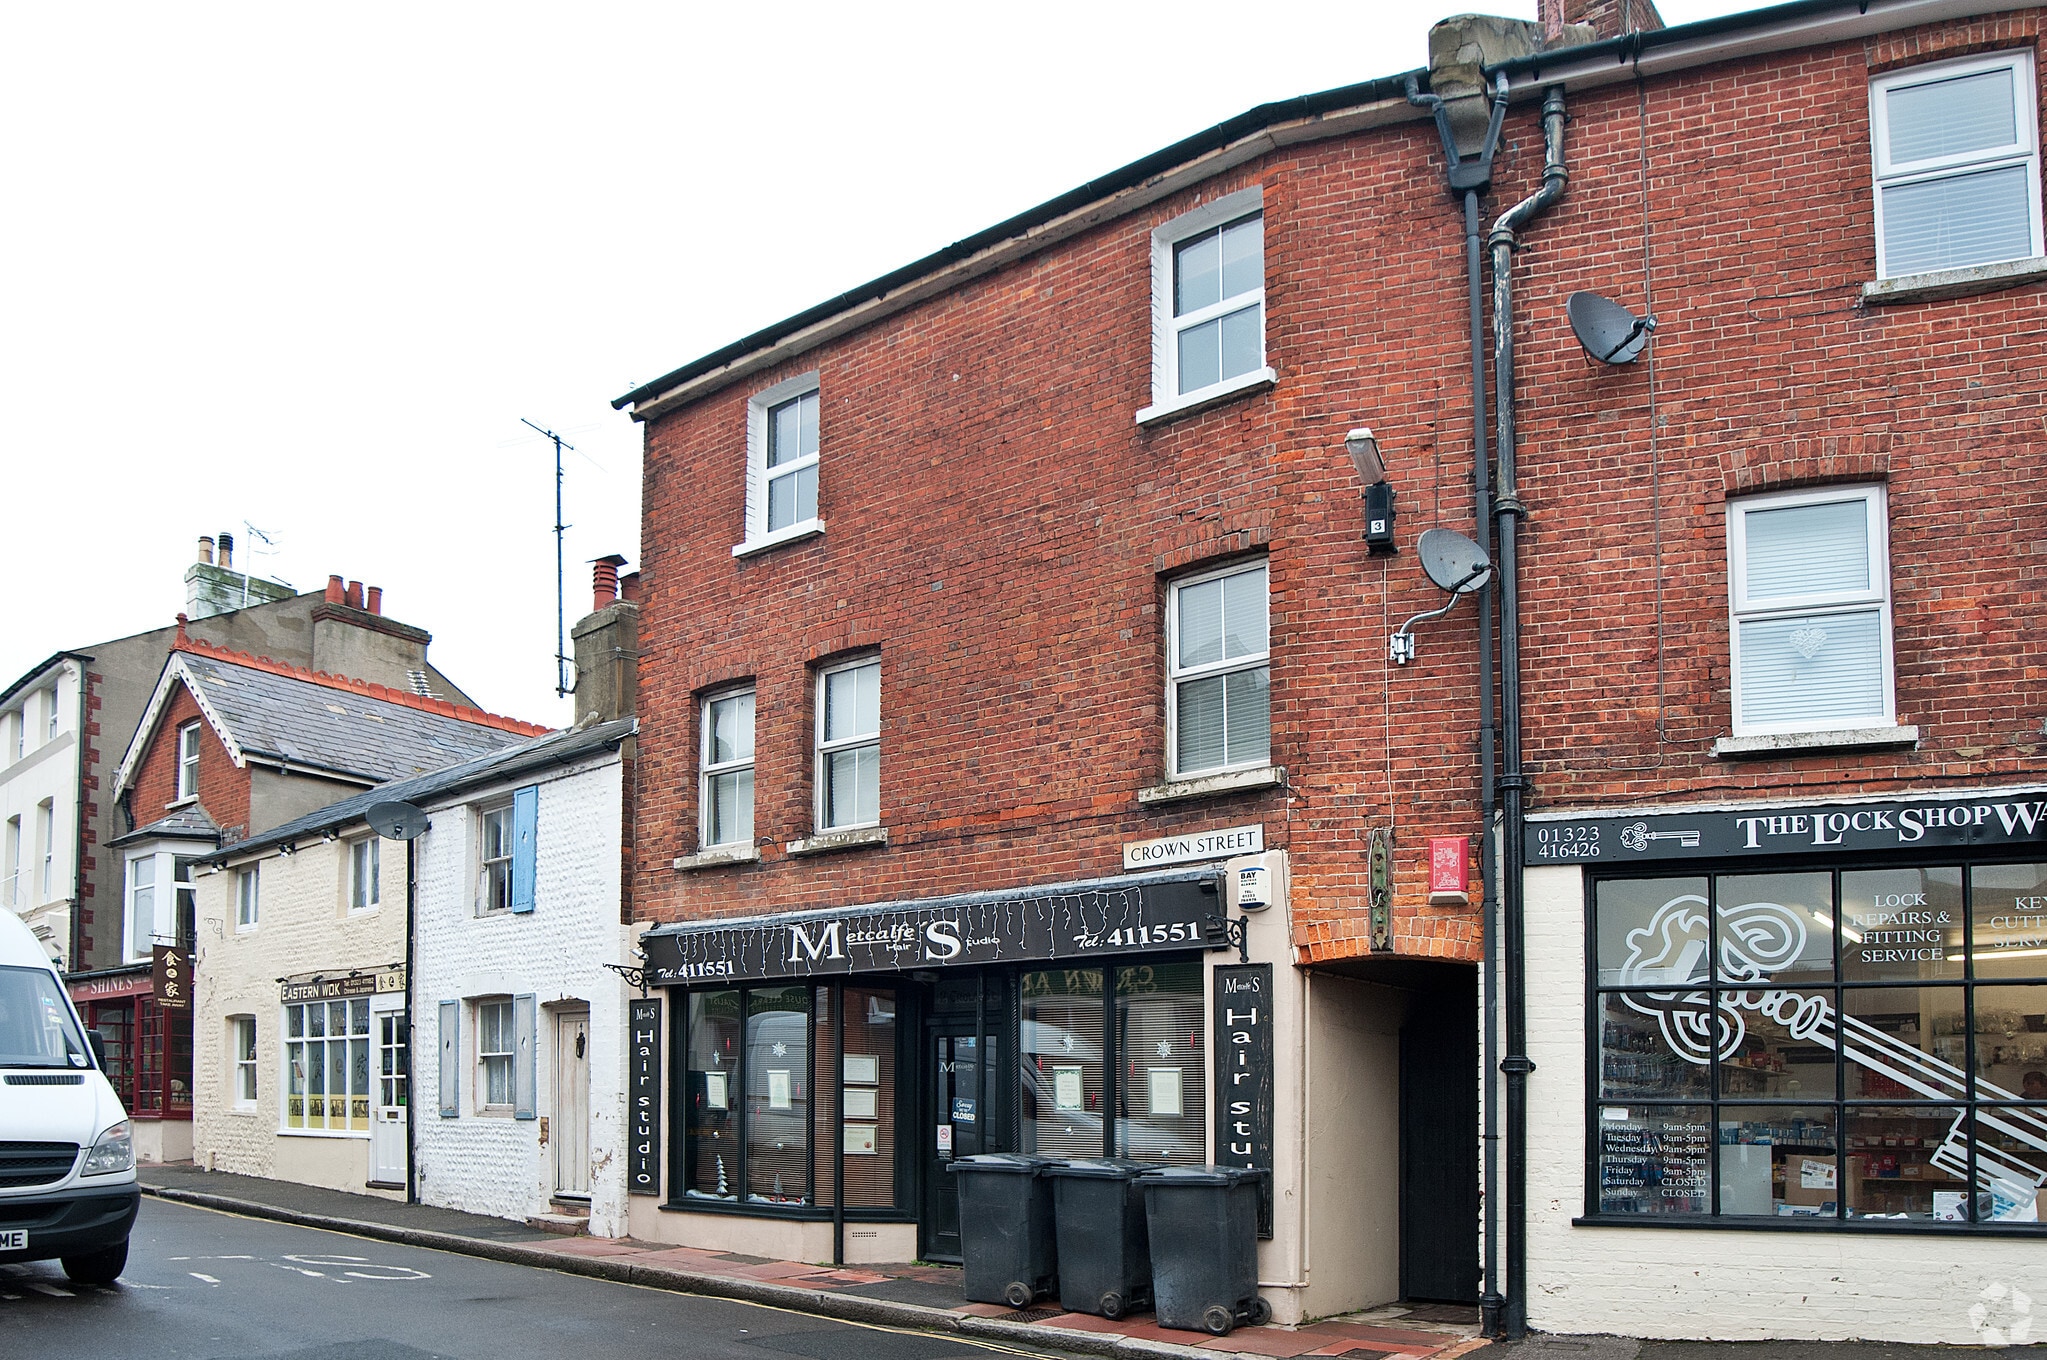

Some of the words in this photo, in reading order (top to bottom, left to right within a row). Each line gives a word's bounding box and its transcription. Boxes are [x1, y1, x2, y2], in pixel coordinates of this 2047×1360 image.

[1374, 522, 1382, 531] 3
[1538, 827, 1600, 843] 01323
[1736, 815, 1809, 849] THE
[1810, 810, 1896, 845] LOCK
[1898, 806, 1992, 842] SHOP
[1130, 840, 1191, 862] CROWN
[1197, 831, 1257, 853] STREET
[1538, 842, 1600, 858] 416426
[1240, 872, 1257, 880] BAY
[1874, 893, 1928, 908] LOCK
[1852, 911, 1932, 927] REPAIRS
[1936, 911, 1952, 924] &
[1990, 915, 2047, 929] CUTT
[1073, 934, 1104, 950] Tel:
[1107, 921, 1202, 947] 411551
[1863, 929, 1941, 945] FITTING
[885, 942, 912, 952] Hair
[1861, 948, 1944, 963] SERVICE
[657, 968, 677, 979] Tel:
[678, 960, 736, 978] 411551
[281, 984, 319, 1001] EASTERN
[322, 982, 341, 997] WOK
[1226, 1007, 1257, 1085] Hair
[636, 1029, 654, 1086] Hair
[956, 1100, 973, 1111] Sorry
[952, 1112, 976, 1121] CLOSED
[1230, 1100, 1253, 1169] stu
[1604, 1123, 1642, 1132] Monday
[1662, 1123, 1706, 1133] 9am-5pm
[637, 1095, 651, 1183] studio
[1606, 1133, 1642, 1143] Tuesday
[1662, 1133, 1706, 1143] 9am-5pm
[1606, 1144, 1656, 1155] Wednesday
[1662, 1145, 1706, 1155] 9am-5pm
[1606, 1155, 1648, 1166] Thursday
[1662, 1156, 1706, 1166] 9am-5pm
[1605, 1166, 1634, 1176] Friday
[1662, 1167, 1706, 1177] 9am-5pm
[1605, 1177, 1645, 1187] Saturday
[1661, 1178, 1706, 1187] CLOSED
[1605, 1188, 1638, 1198] Sunday
[1661, 1189, 1706, 1198] CLOSED
